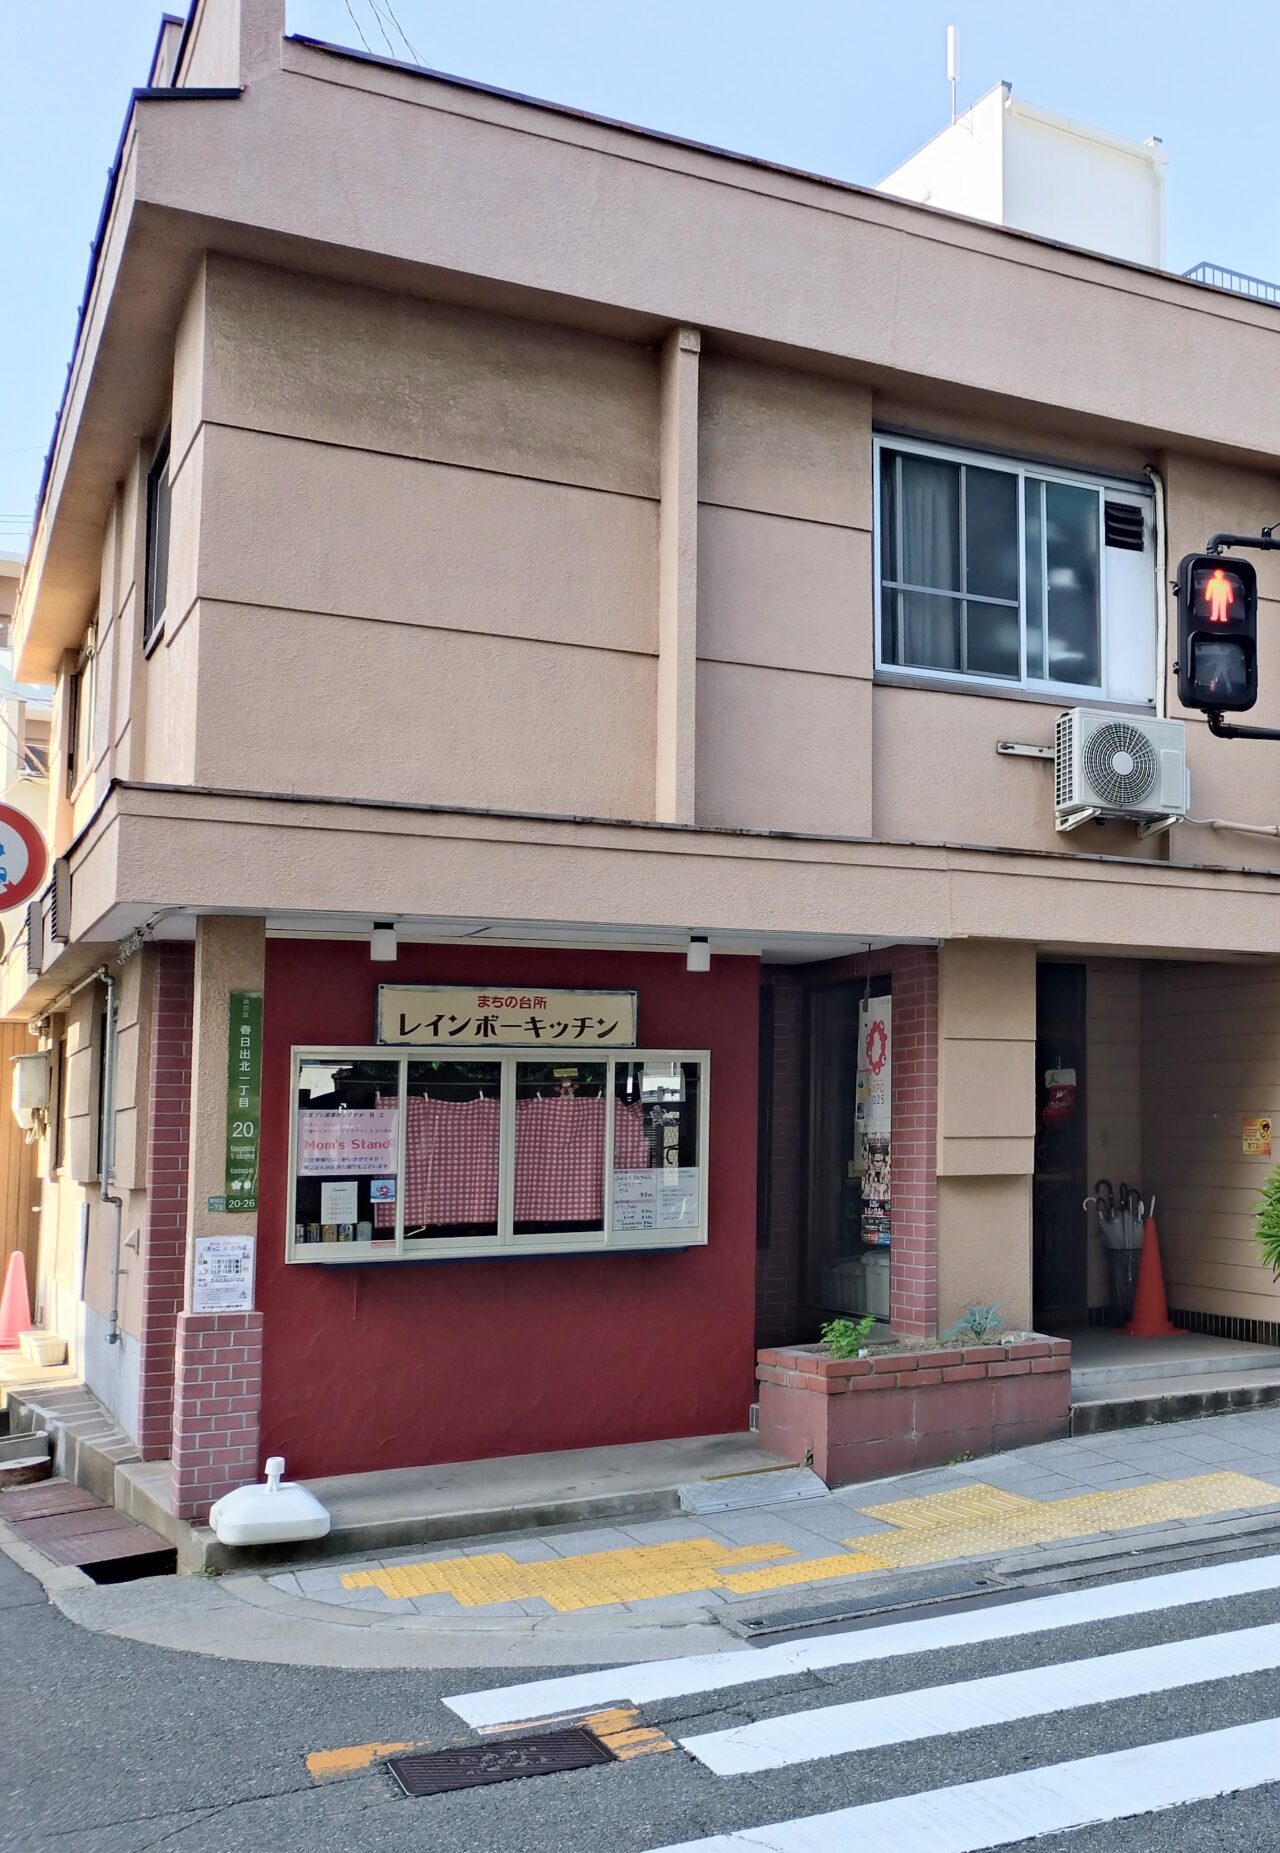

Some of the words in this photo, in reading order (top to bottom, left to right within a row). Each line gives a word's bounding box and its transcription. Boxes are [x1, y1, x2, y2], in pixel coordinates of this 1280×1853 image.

[477, 995, 547, 1010] まちの台所
[399, 1012, 619, 1039] レインボーキッチン
[238, 1024, 252, 1108] 春日出北一丁目
[232, 1121, 255, 1138] 20
[304, 1140, 346, 1150] Mom's
[228, 1199, 256, 1208] 20-26
